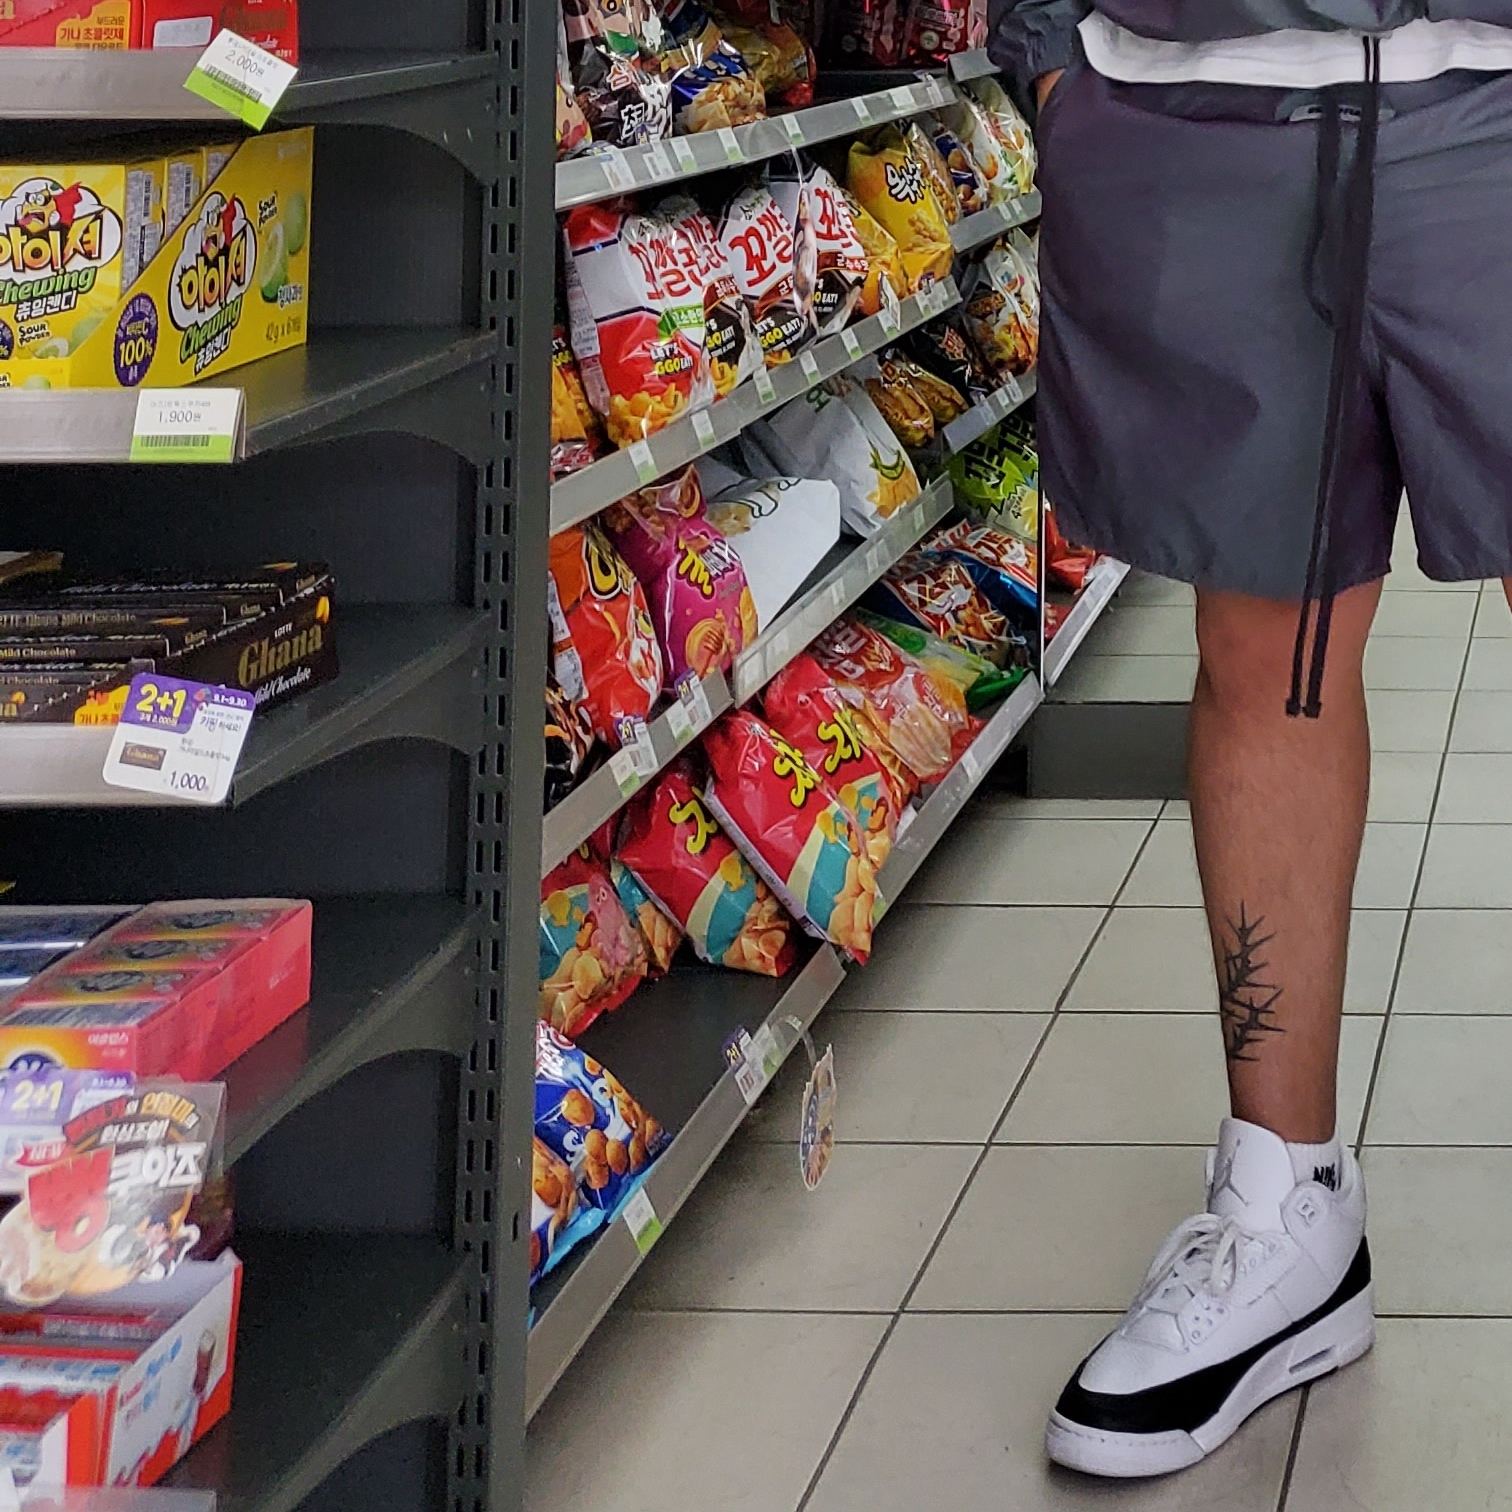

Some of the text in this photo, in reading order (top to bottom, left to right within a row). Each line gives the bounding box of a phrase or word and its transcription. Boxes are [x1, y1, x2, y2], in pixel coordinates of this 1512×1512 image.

[180, 293, 242, 363] Chewing
[238, 625, 321, 687] Ghana
[137, 684, 187, 718] 2+1
